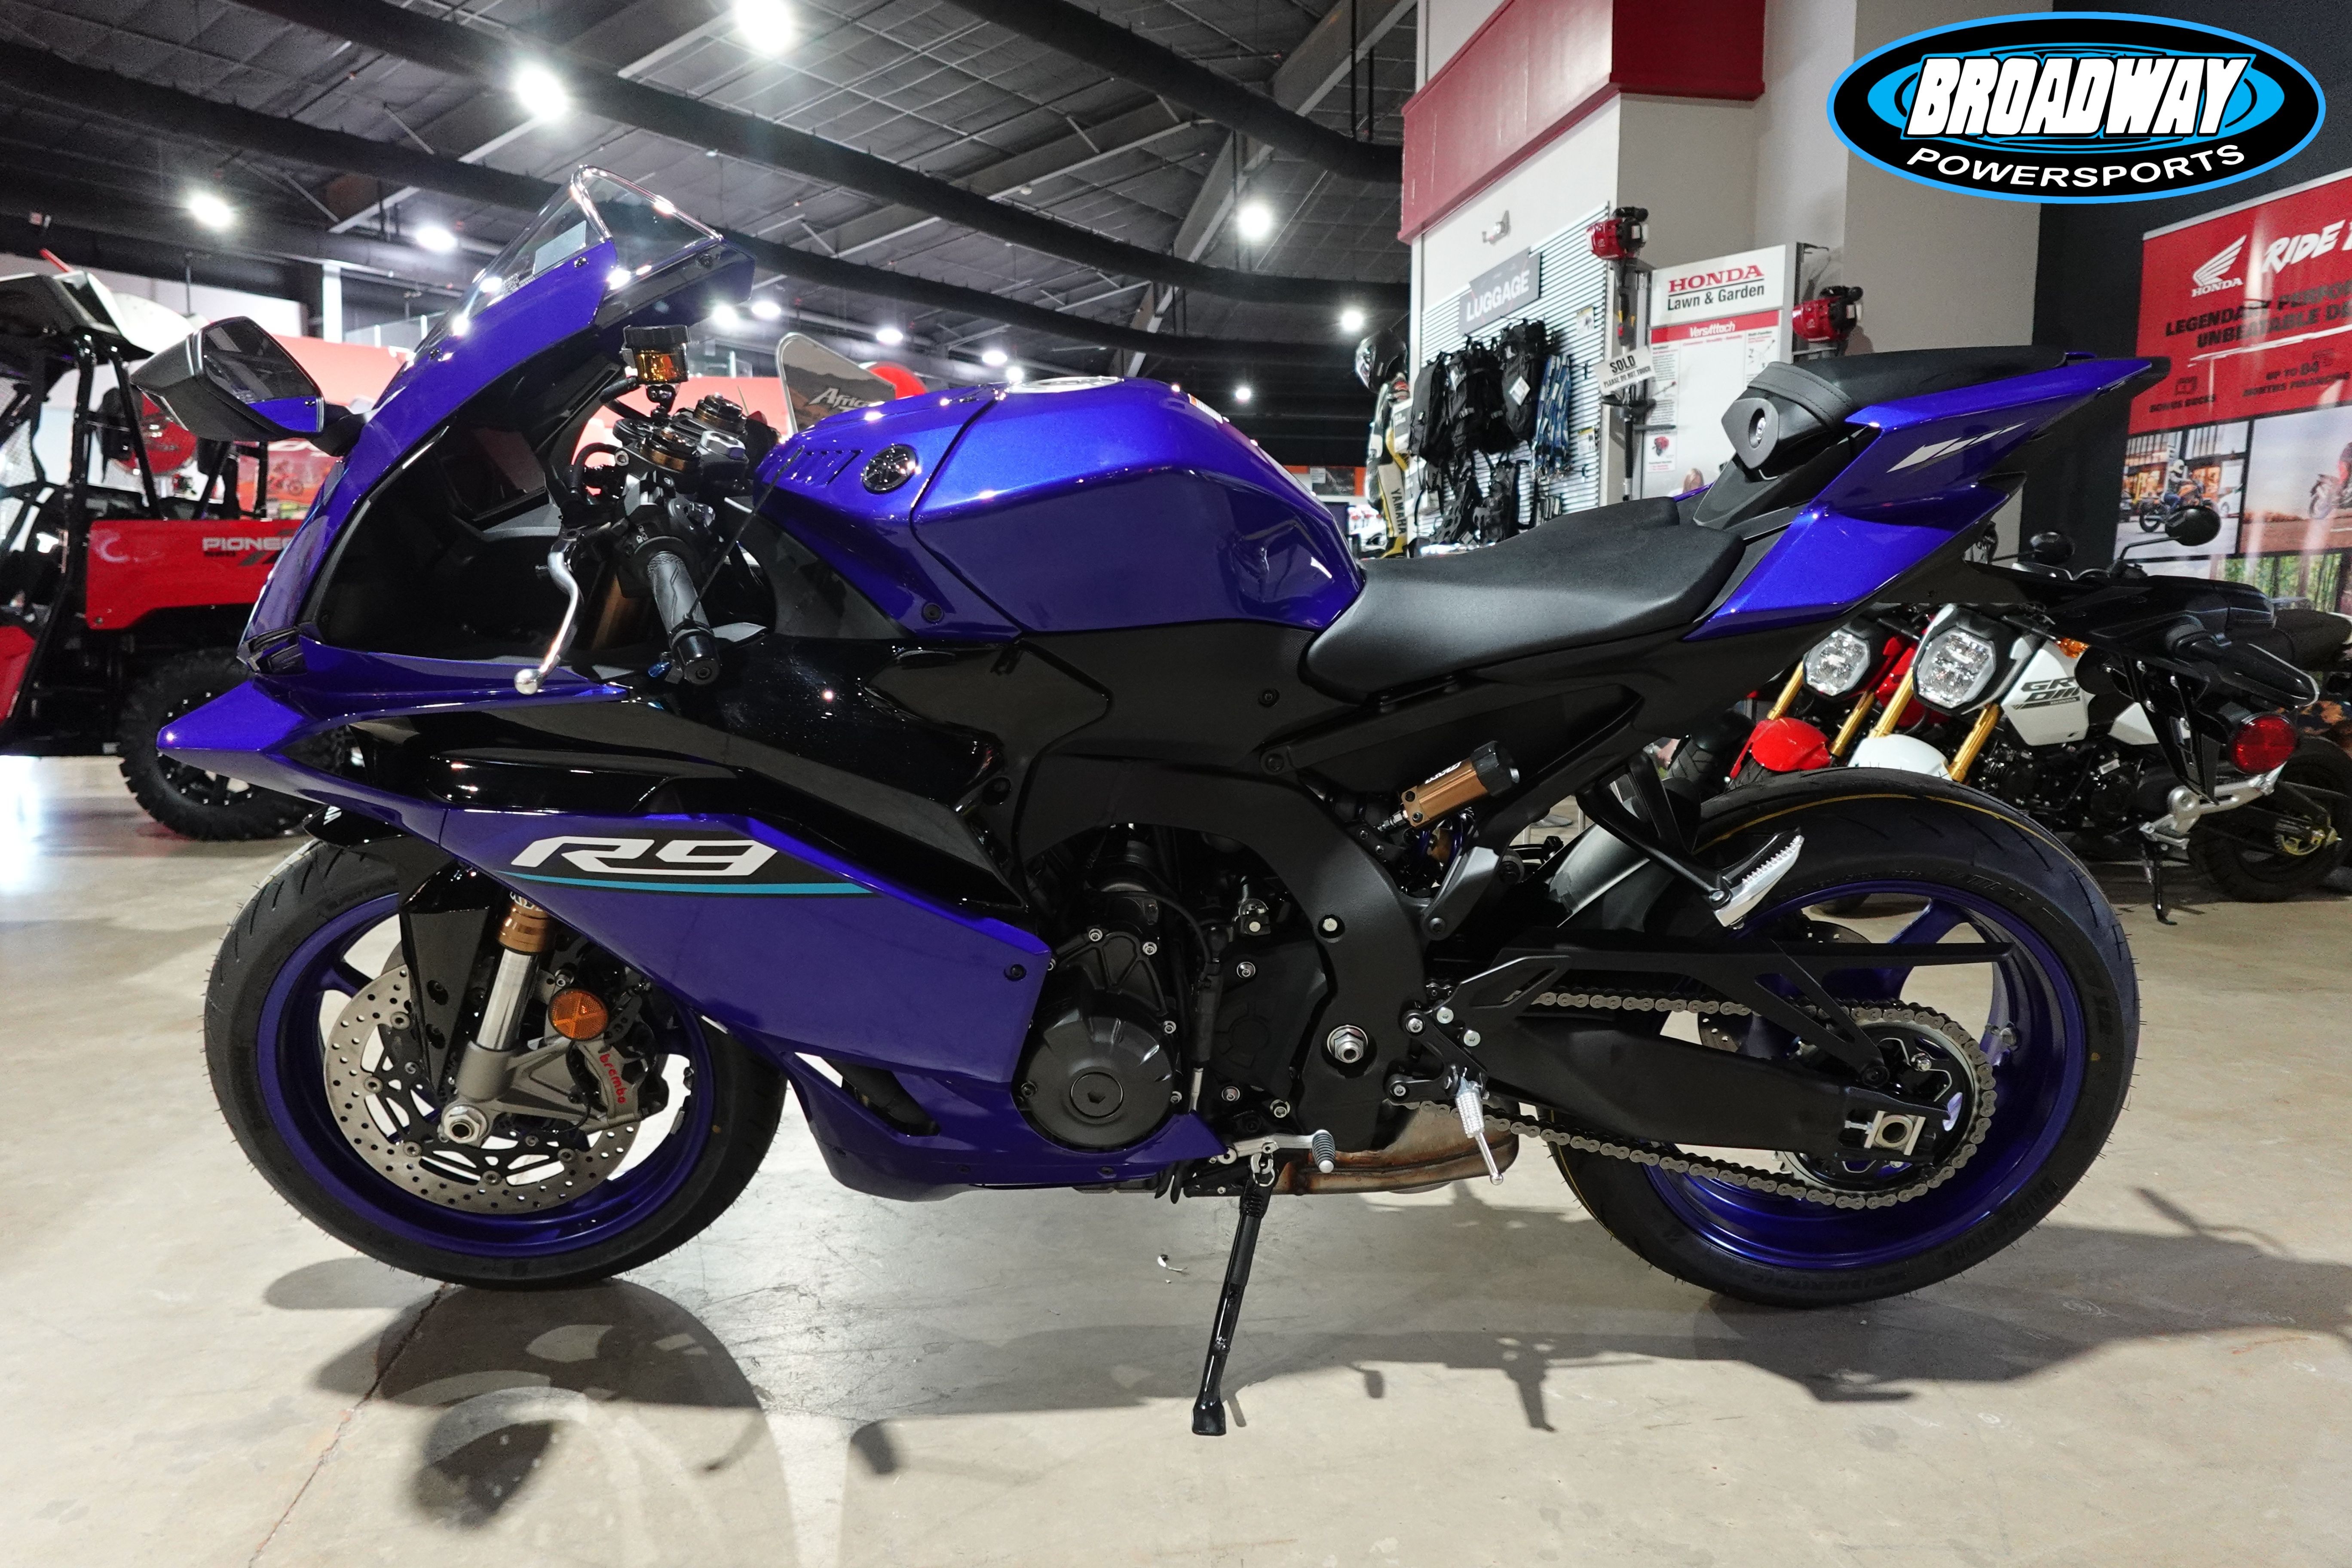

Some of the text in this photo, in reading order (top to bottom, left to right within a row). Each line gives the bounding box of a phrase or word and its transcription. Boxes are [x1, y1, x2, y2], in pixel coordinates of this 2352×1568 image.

[2261, 220, 2346, 274] RIDE
[1668, 265, 1764, 293] HONDA
[2192, 277, 2244, 297] HONDA
[1466, 270, 1530, 322] LUGGAGE
[1668, 285, 1764, 311] Lawn & Garden
[1690, 321, 1736, 338] VersAttach
[1603, 377, 1619, 389] PLEASE
[1637, 365, 1651, 376] TOUCH
[1609, 355, 1636, 374] SOLD
[1391, 488, 1407, 534] YAMAHA
[511, 836, 778, 876] R9
[600, 1054, 628, 1104] brembo
